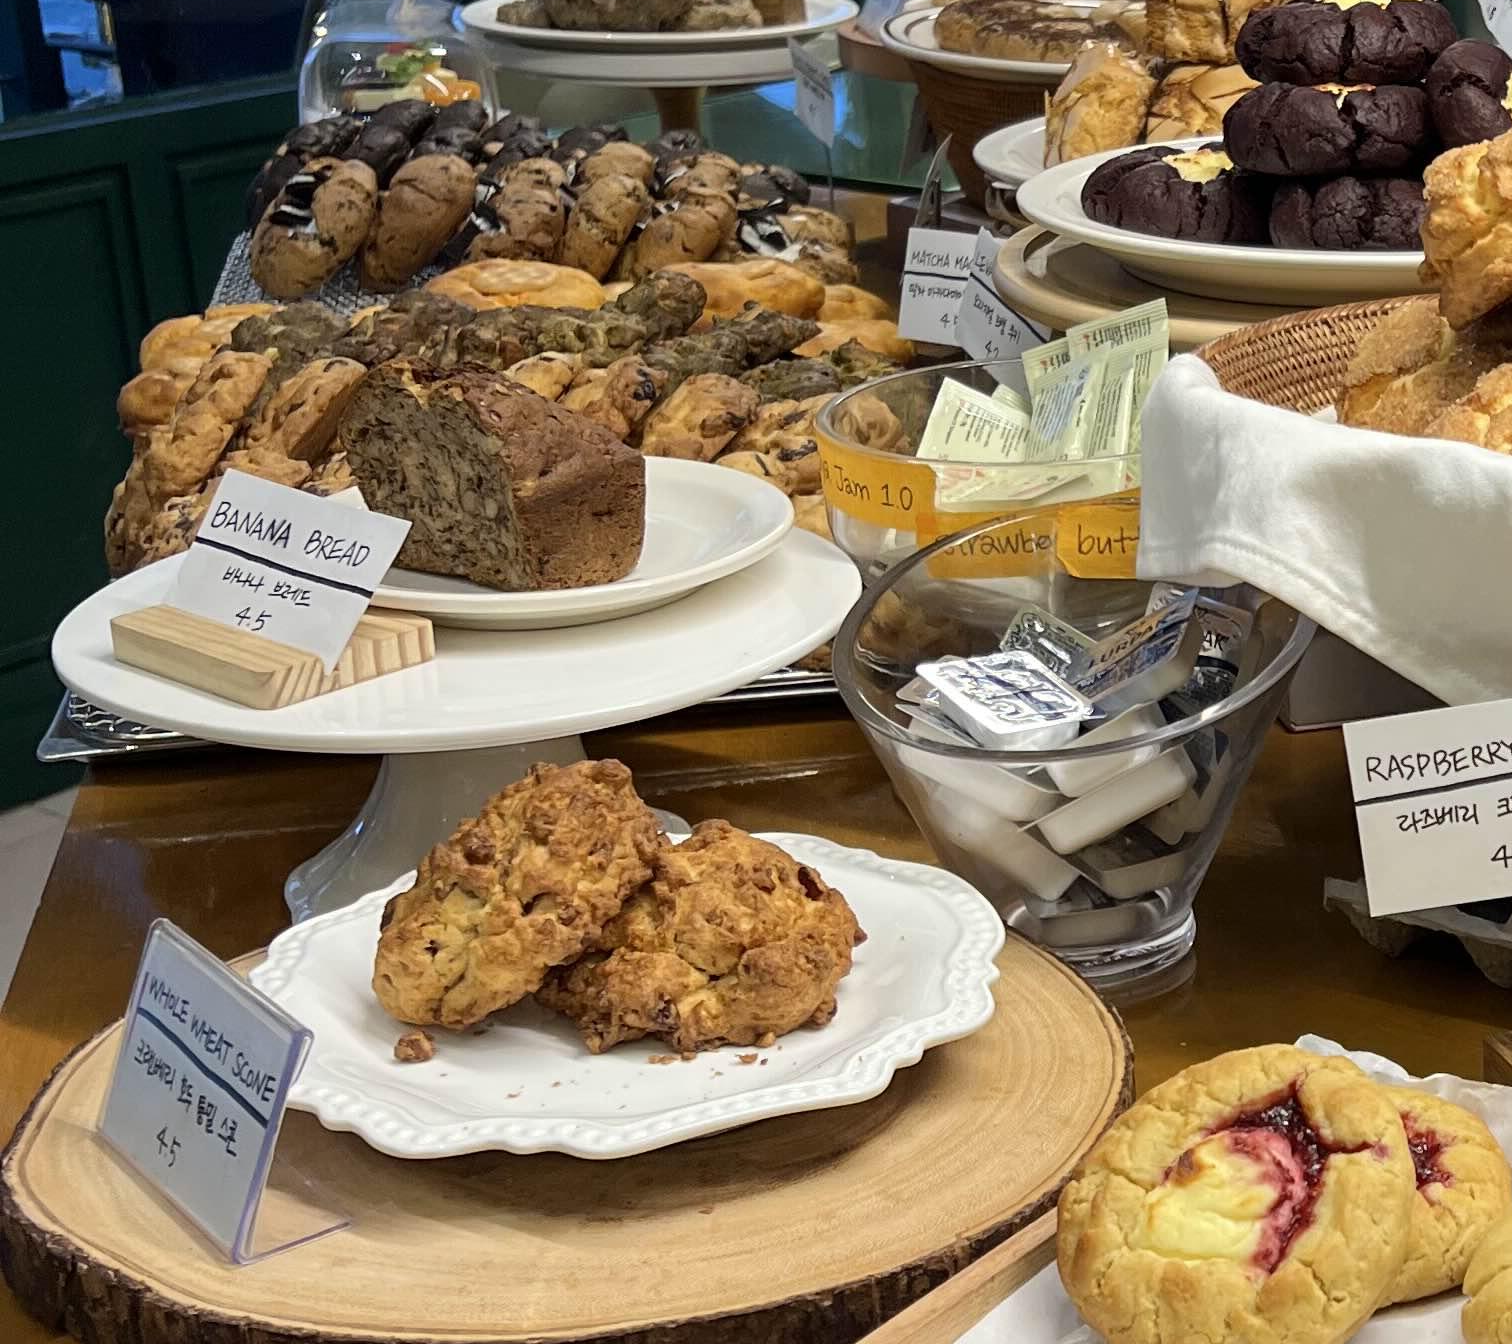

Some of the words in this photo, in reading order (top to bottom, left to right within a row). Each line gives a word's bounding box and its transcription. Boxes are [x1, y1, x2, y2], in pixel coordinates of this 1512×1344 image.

[911, 249, 951, 269] MATCHA
[833, 464, 871, 501] Jam
[880, 483, 914, 512] 1.0
[210, 501, 292, 549] BANANA
[303, 529, 371, 567] BREAD
[222, 566, 265, 594] 바나나
[268, 581, 312, 607] 브레드
[235, 607, 272, 632] 4.5
[1396, 803, 1480, 834] 라즈베리
[149, 975, 190, 1024] WHOLE
[190, 1017, 234, 1066] WHEAT
[232, 1051, 277, 1103] SCONE
[156, 1125, 182, 1167] 4.5
[217, 1117, 238, 1157] 스콘
